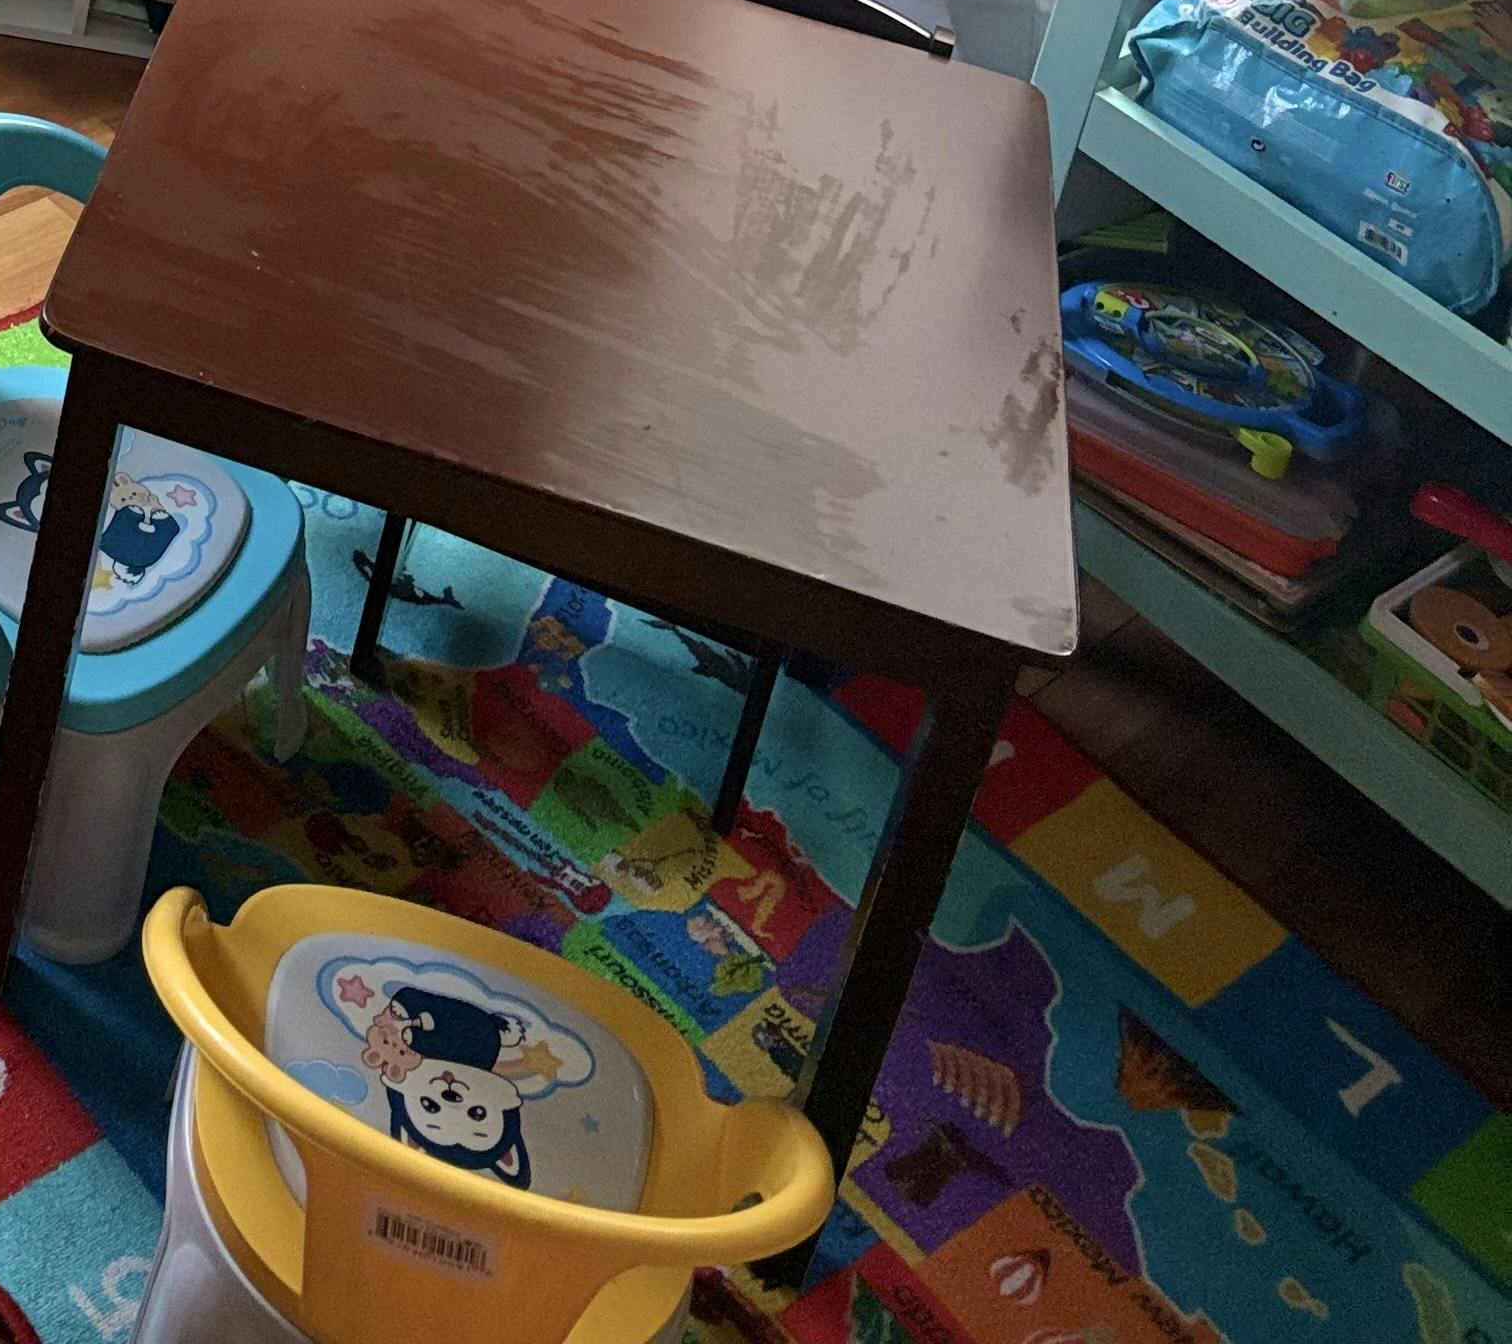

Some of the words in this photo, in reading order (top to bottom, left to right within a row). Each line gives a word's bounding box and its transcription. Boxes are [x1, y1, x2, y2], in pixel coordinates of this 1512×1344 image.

[1238, 8, 1329, 72] Building
[1329, 62, 1377, 93] Bag
[1324, 1016, 1403, 1116] L
